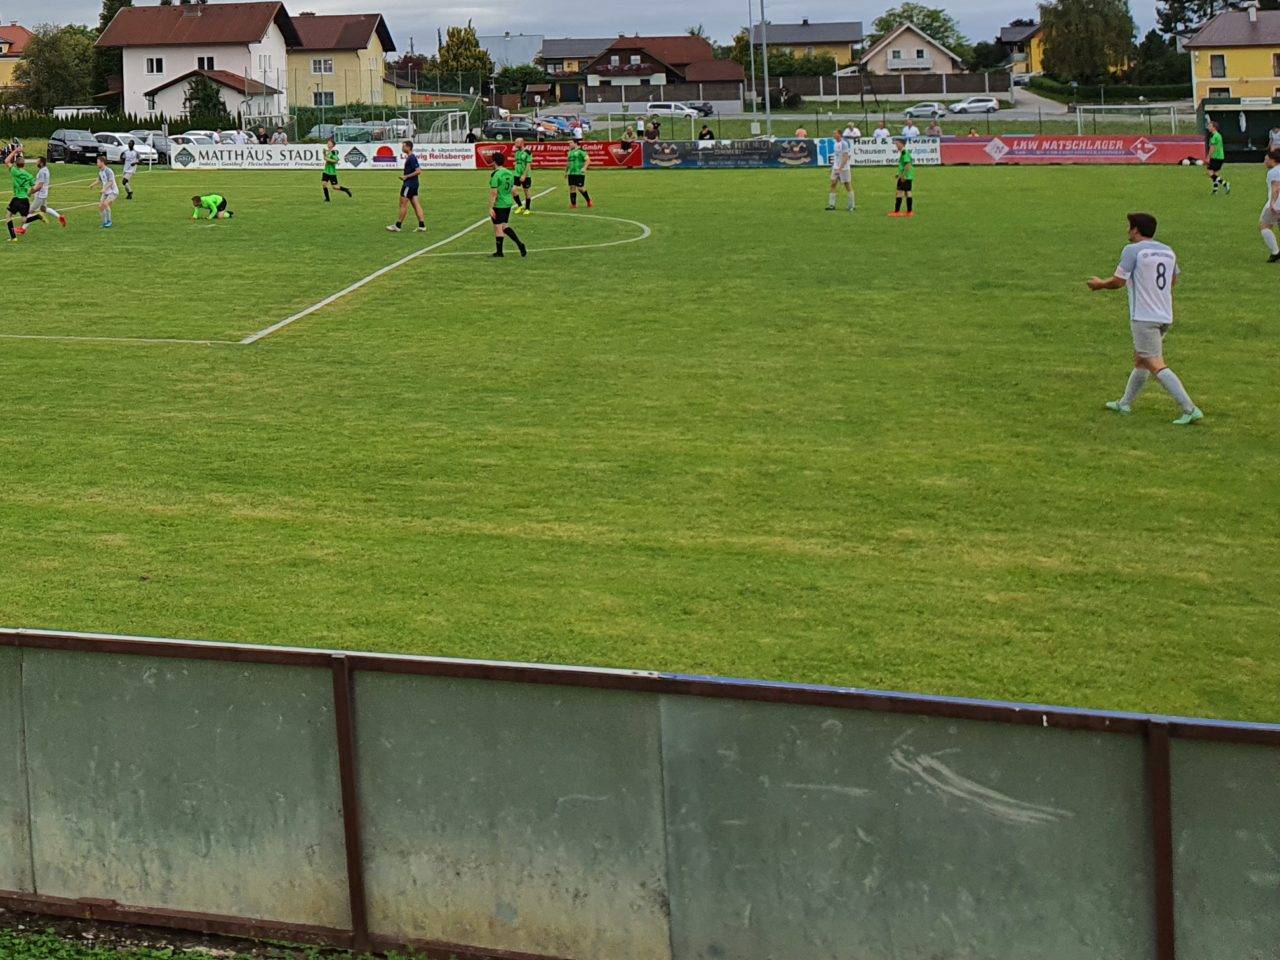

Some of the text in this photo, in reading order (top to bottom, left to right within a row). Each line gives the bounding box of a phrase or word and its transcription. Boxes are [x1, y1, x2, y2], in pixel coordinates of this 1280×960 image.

[1013, 140, 1039, 150] LKW
[198, 147, 273, 161] MATTHÄUS
[429, 153, 473, 161] Reitsberger
[1156, 262, 1166, 290] 8
